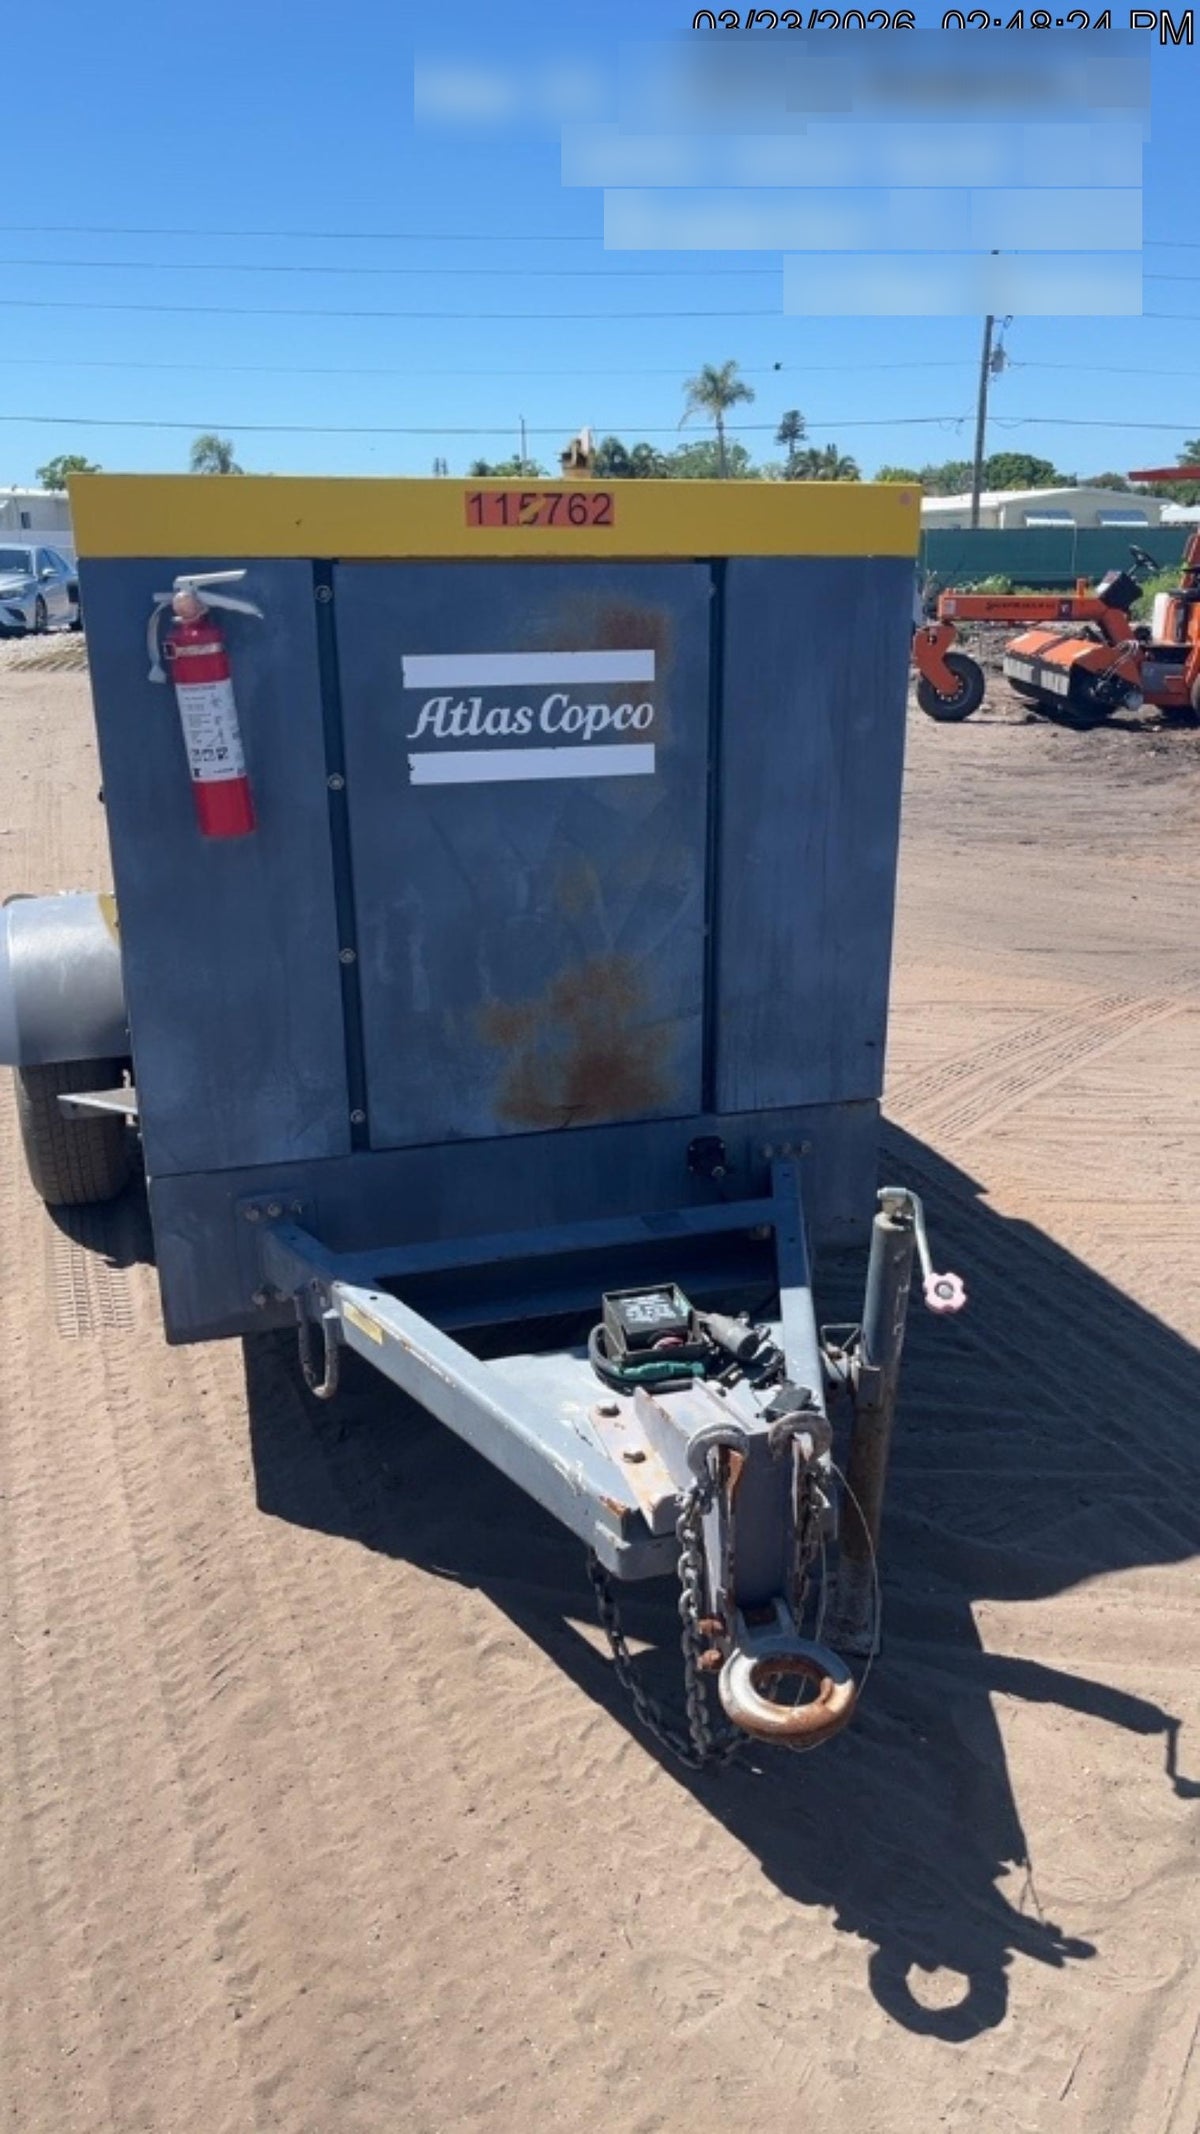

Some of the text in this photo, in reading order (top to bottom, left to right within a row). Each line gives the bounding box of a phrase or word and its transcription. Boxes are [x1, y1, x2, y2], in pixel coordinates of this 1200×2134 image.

[469, 492, 612, 525] 115762
[406, 693, 654, 741] Atlas Copco
